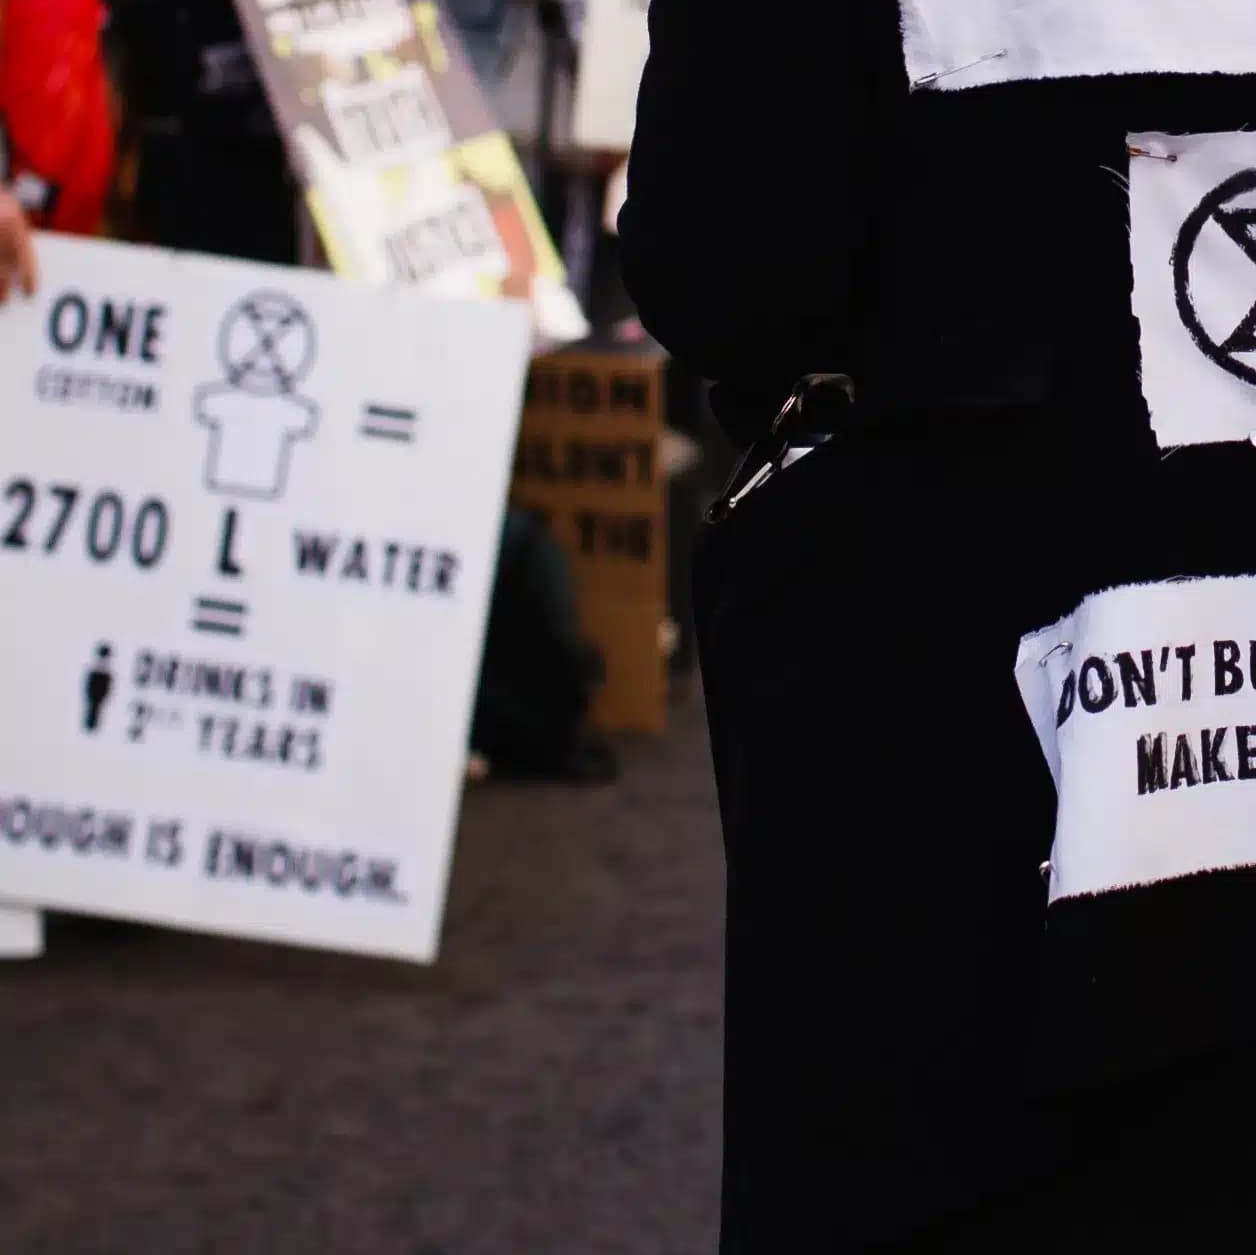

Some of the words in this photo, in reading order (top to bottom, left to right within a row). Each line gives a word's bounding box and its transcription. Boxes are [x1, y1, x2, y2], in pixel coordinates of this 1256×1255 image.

[47, 292, 166, 363] ONE
[3, 477, 170, 570] 2700
[217, 506, 243, 577] L
[294, 529, 458, 596] WATER
[133, 648, 273, 707] DRINKS
[291, 678, 333, 715] IN
[1055, 642, 1196, 730] DON'T
[199, 714, 322, 771] YEARS
[0, 799, 132, 857] OUGH
[145, 816, 183, 867] IS
